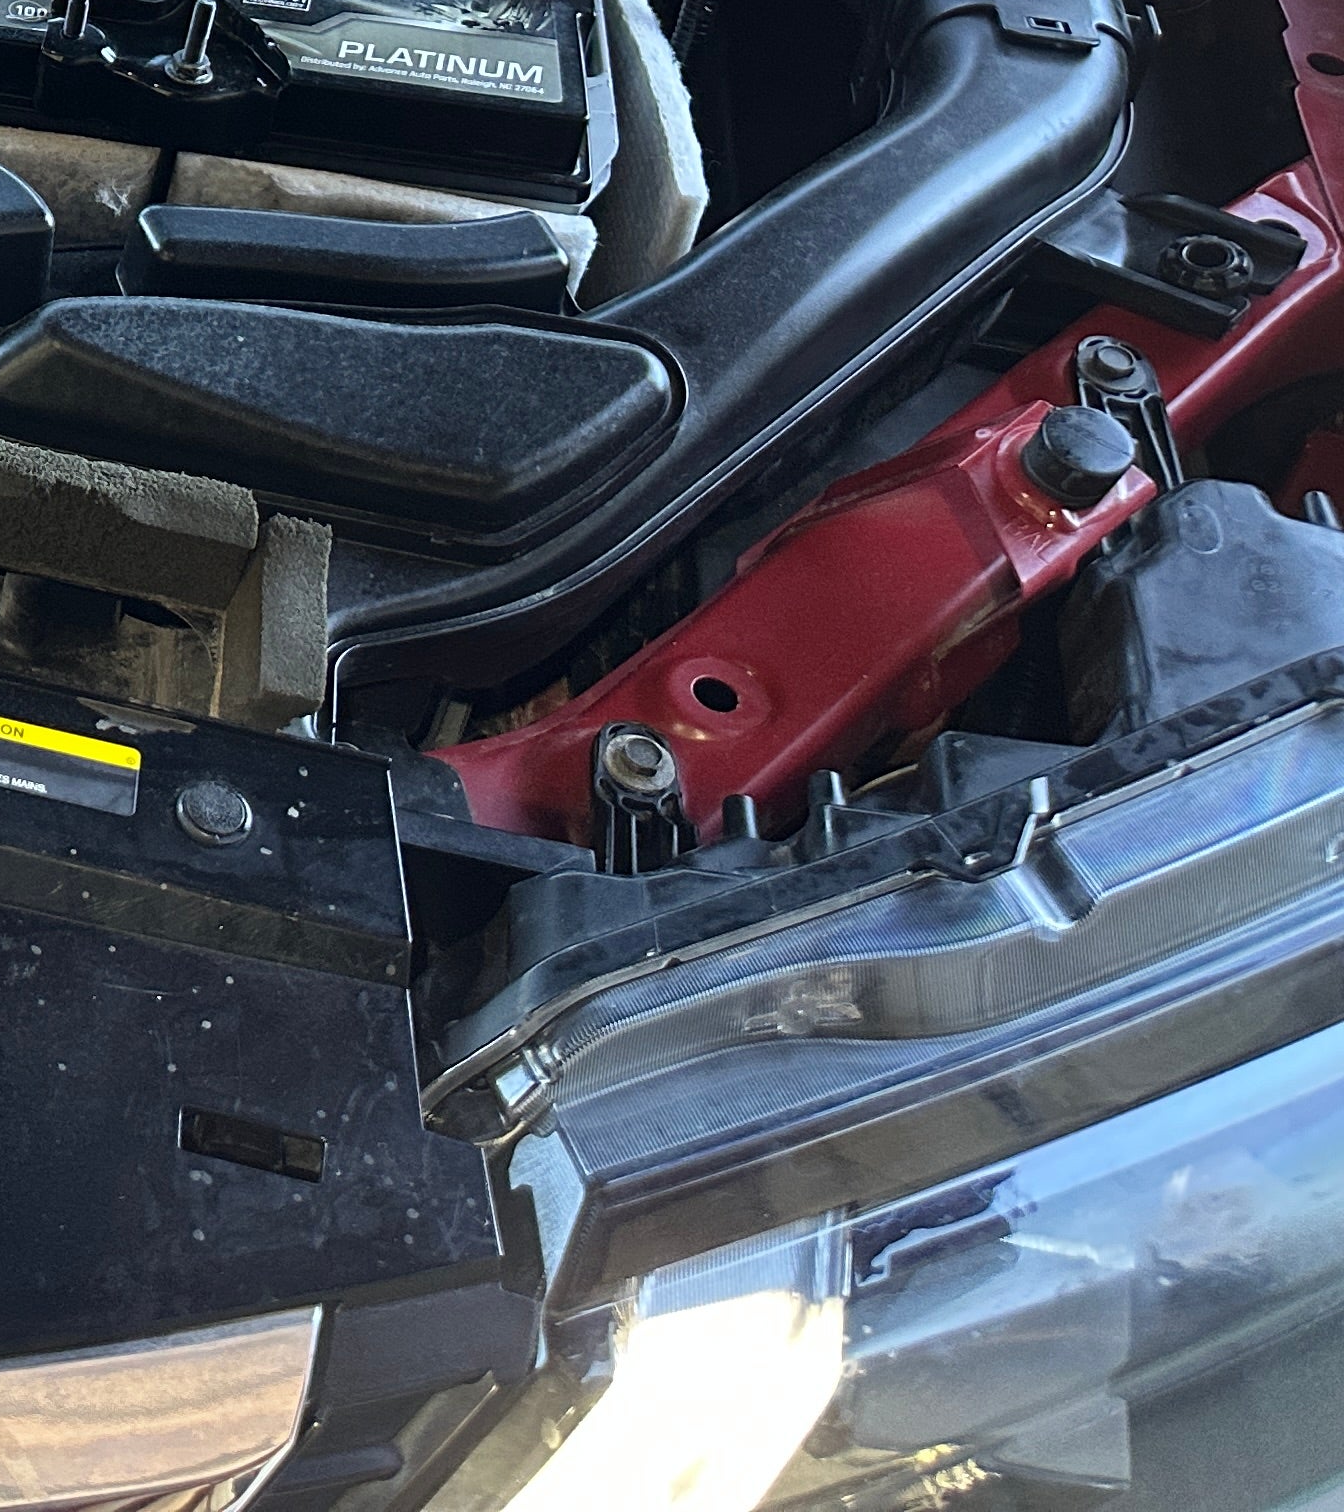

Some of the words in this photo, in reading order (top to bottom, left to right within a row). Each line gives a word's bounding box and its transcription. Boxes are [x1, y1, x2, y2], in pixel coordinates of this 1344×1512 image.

[300, 55, 352, 69] Distributed
[368, 65, 408, 77] Advance
[409, 70, 432, 81] Auto
[338, 40, 544, 84] PLATINUM
